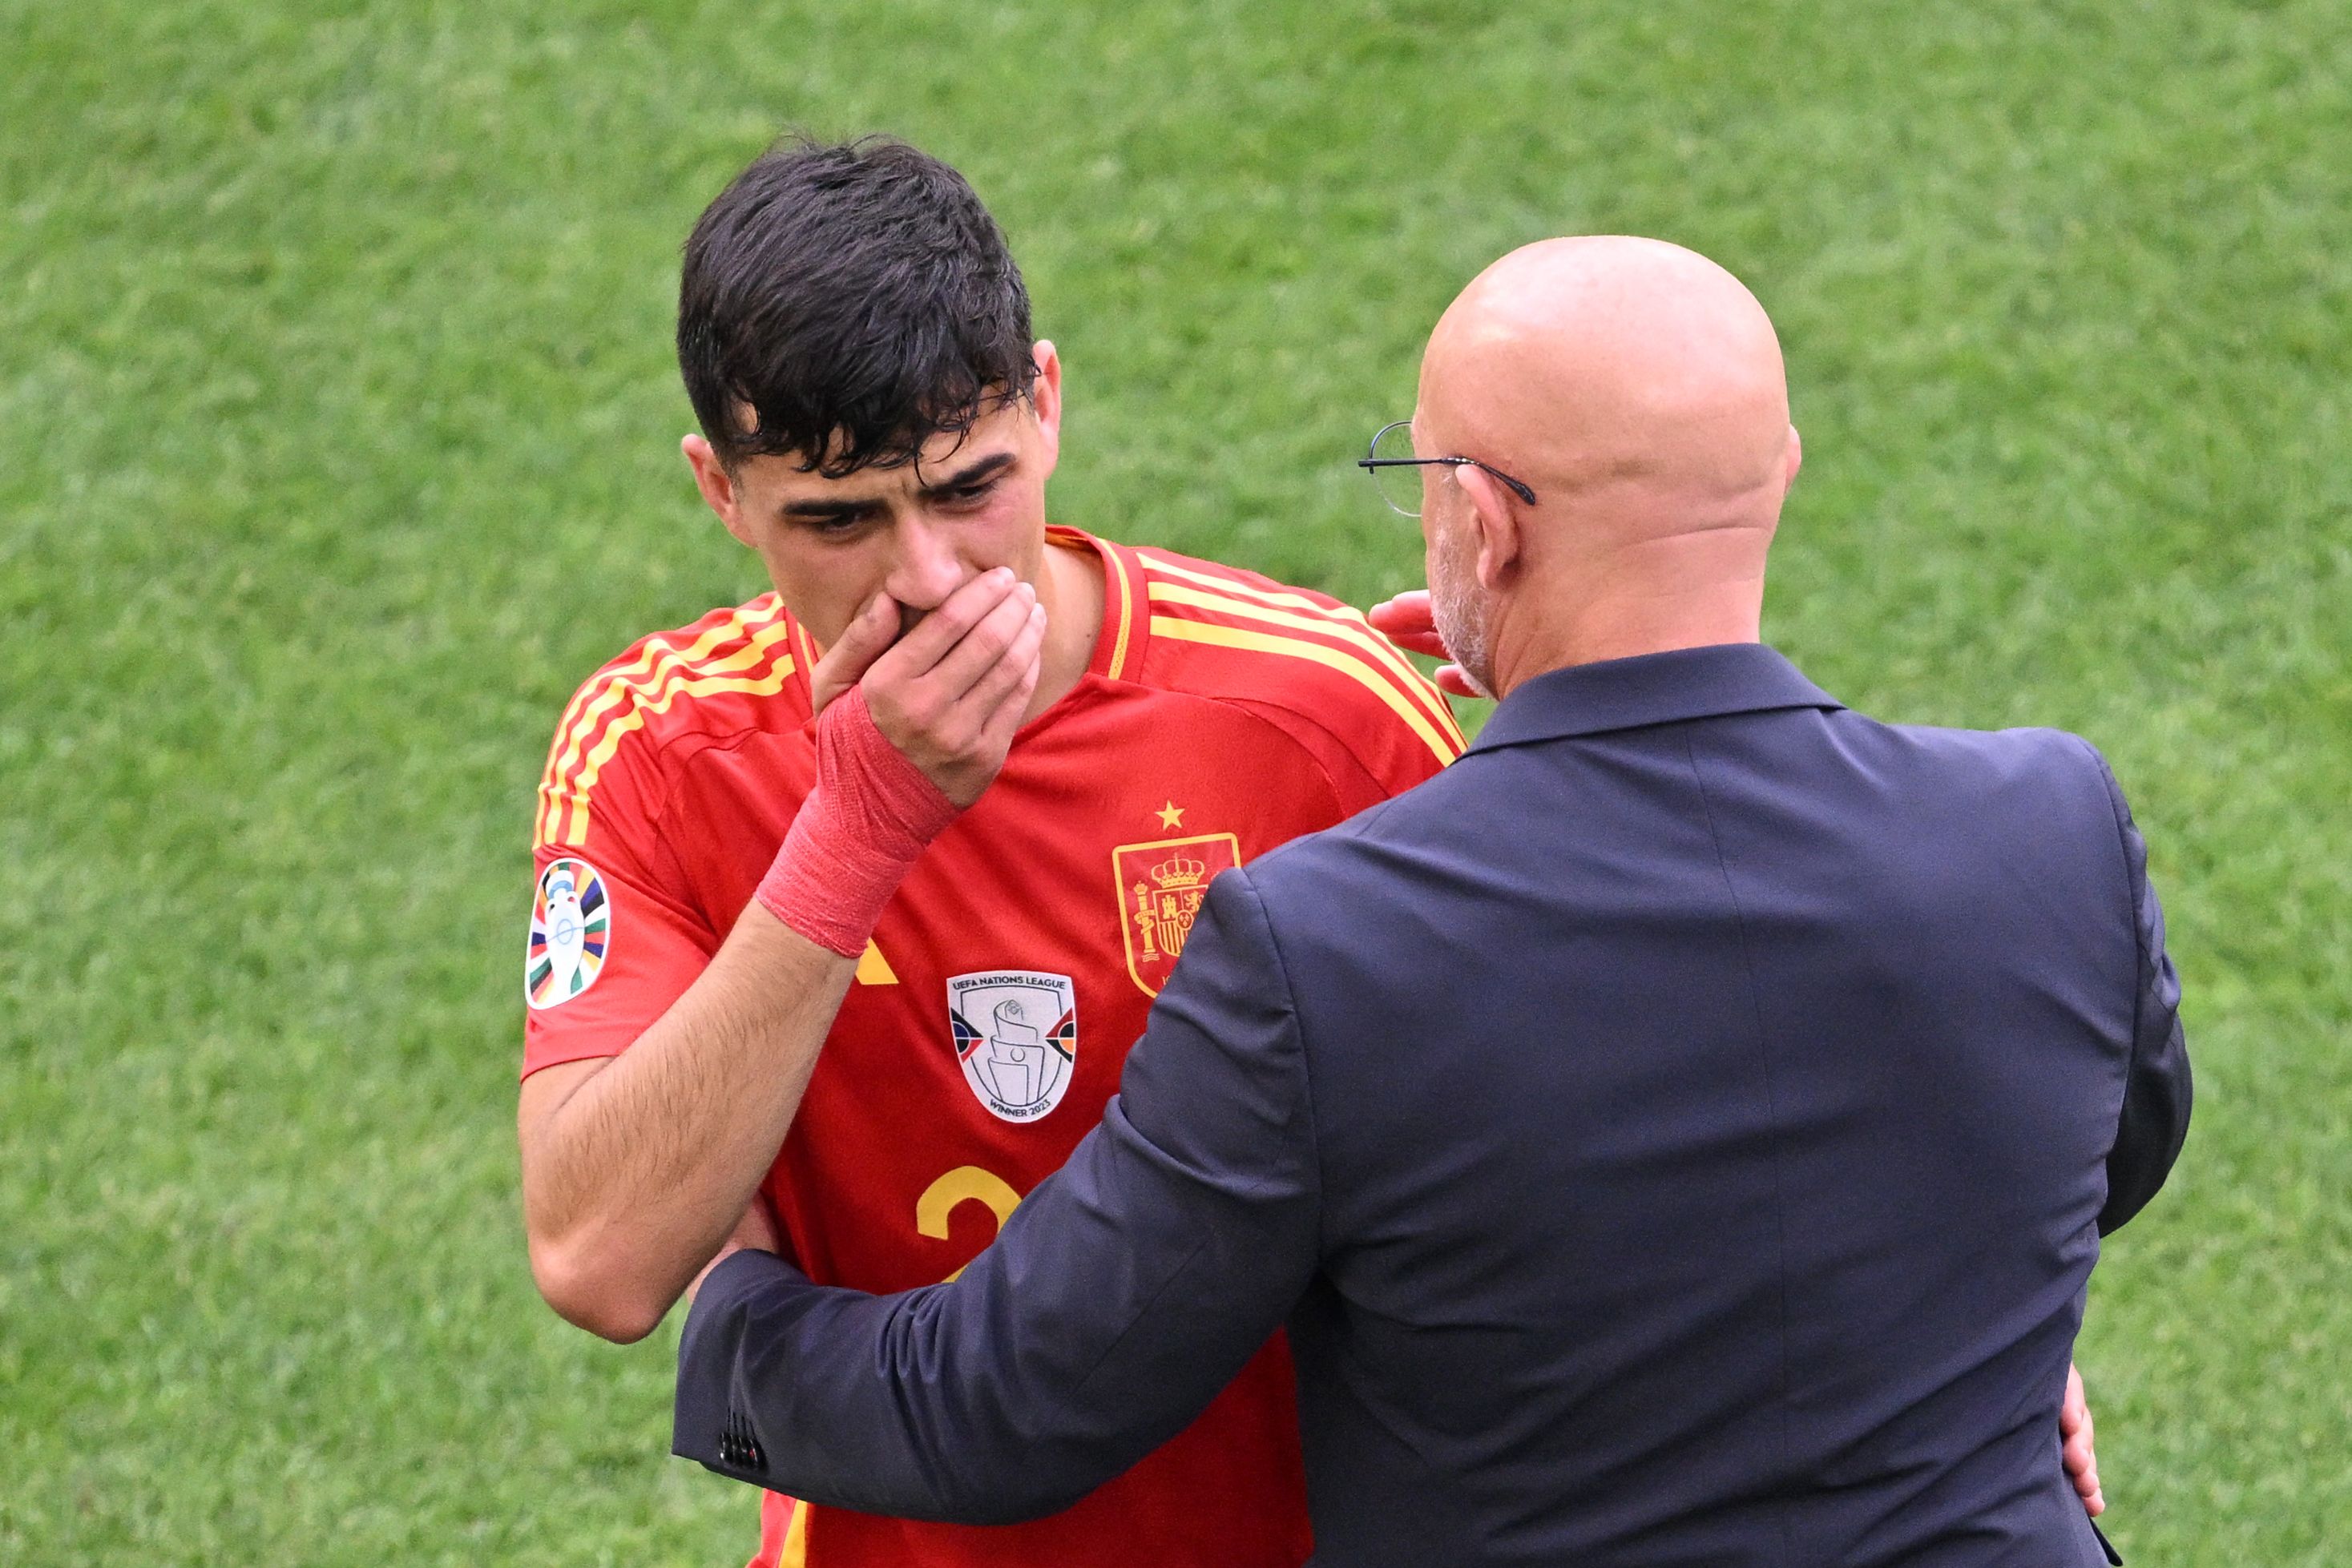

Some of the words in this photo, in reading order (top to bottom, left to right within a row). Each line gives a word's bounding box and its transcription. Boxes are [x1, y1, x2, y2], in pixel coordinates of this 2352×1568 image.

[953, 979, 978, 990] UEFA
[979, 976, 1023, 986] NATIONS
[1026, 977, 1066, 990] LEAGUE
[990, 1099, 1027, 1117] WINNER
[1030, 1098, 1051, 1115] 2023
